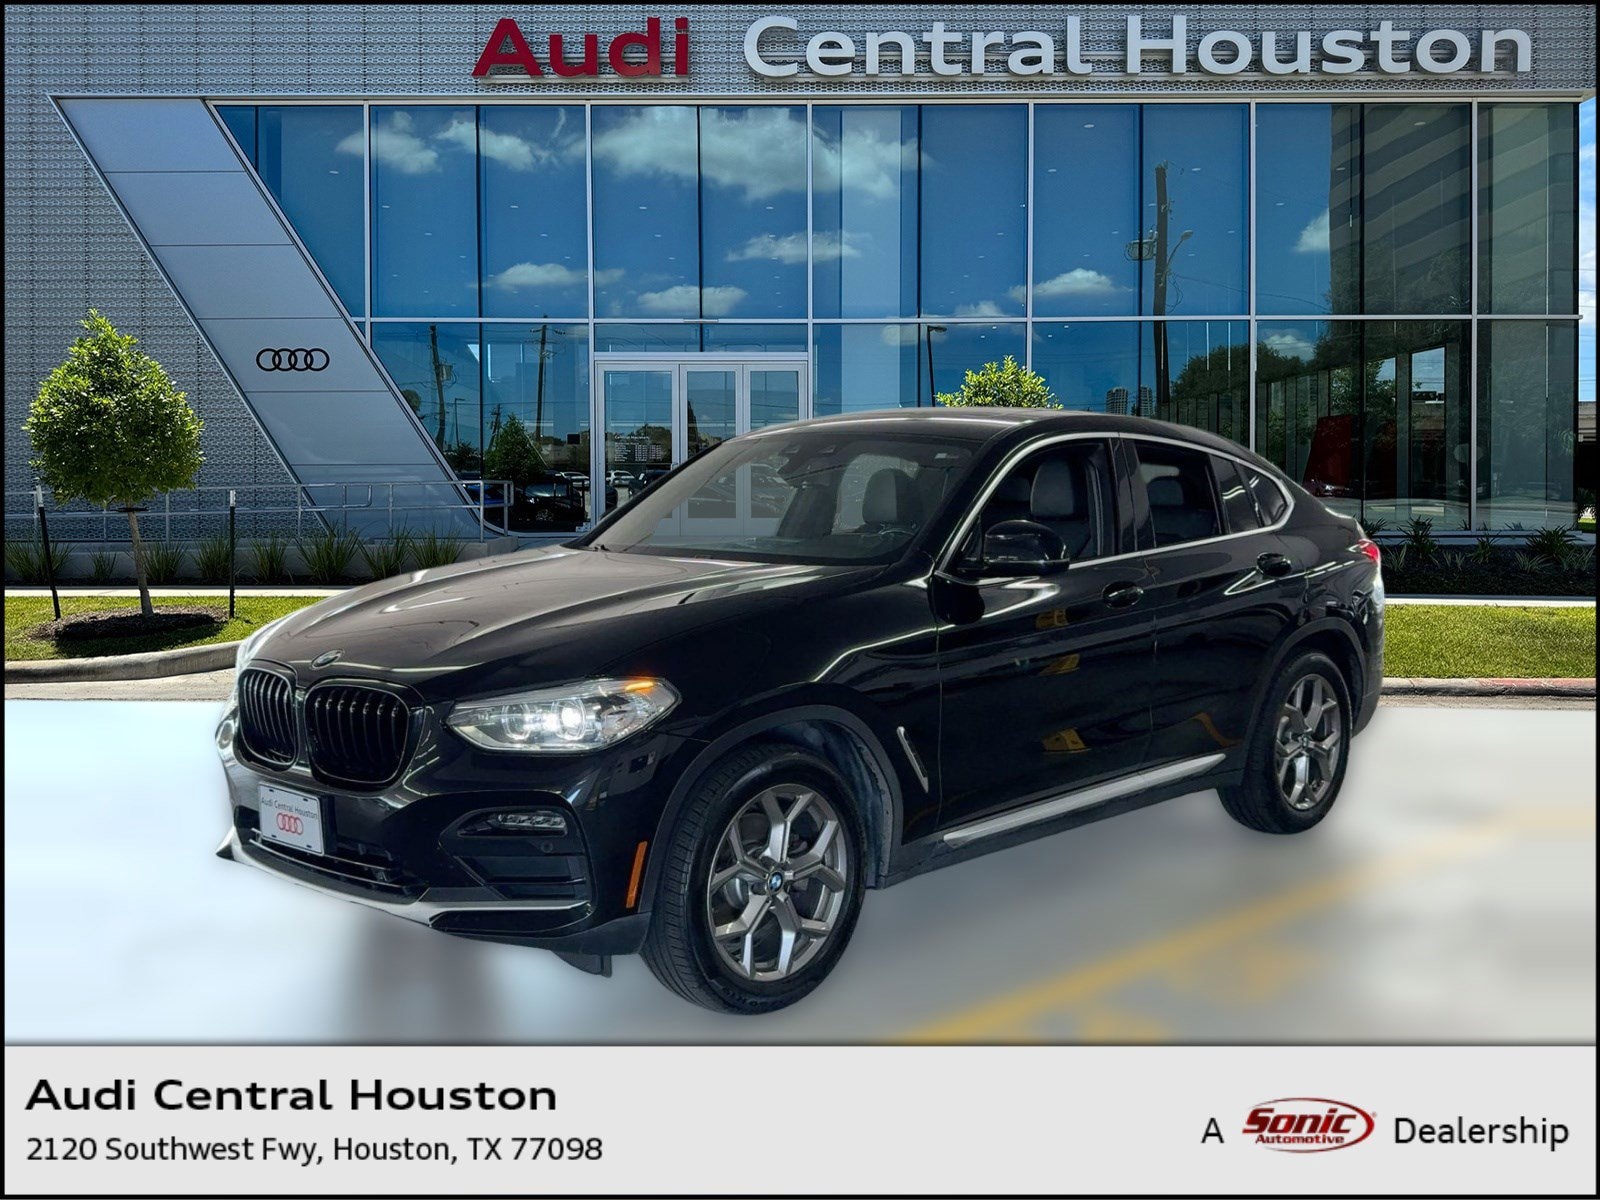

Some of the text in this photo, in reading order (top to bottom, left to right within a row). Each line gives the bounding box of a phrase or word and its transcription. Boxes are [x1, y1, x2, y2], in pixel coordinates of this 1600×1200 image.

[471, 14, 1532, 78] Audi Central Houston
[274, 800, 294, 812] Central
[294, 806, 318, 819] Houston
